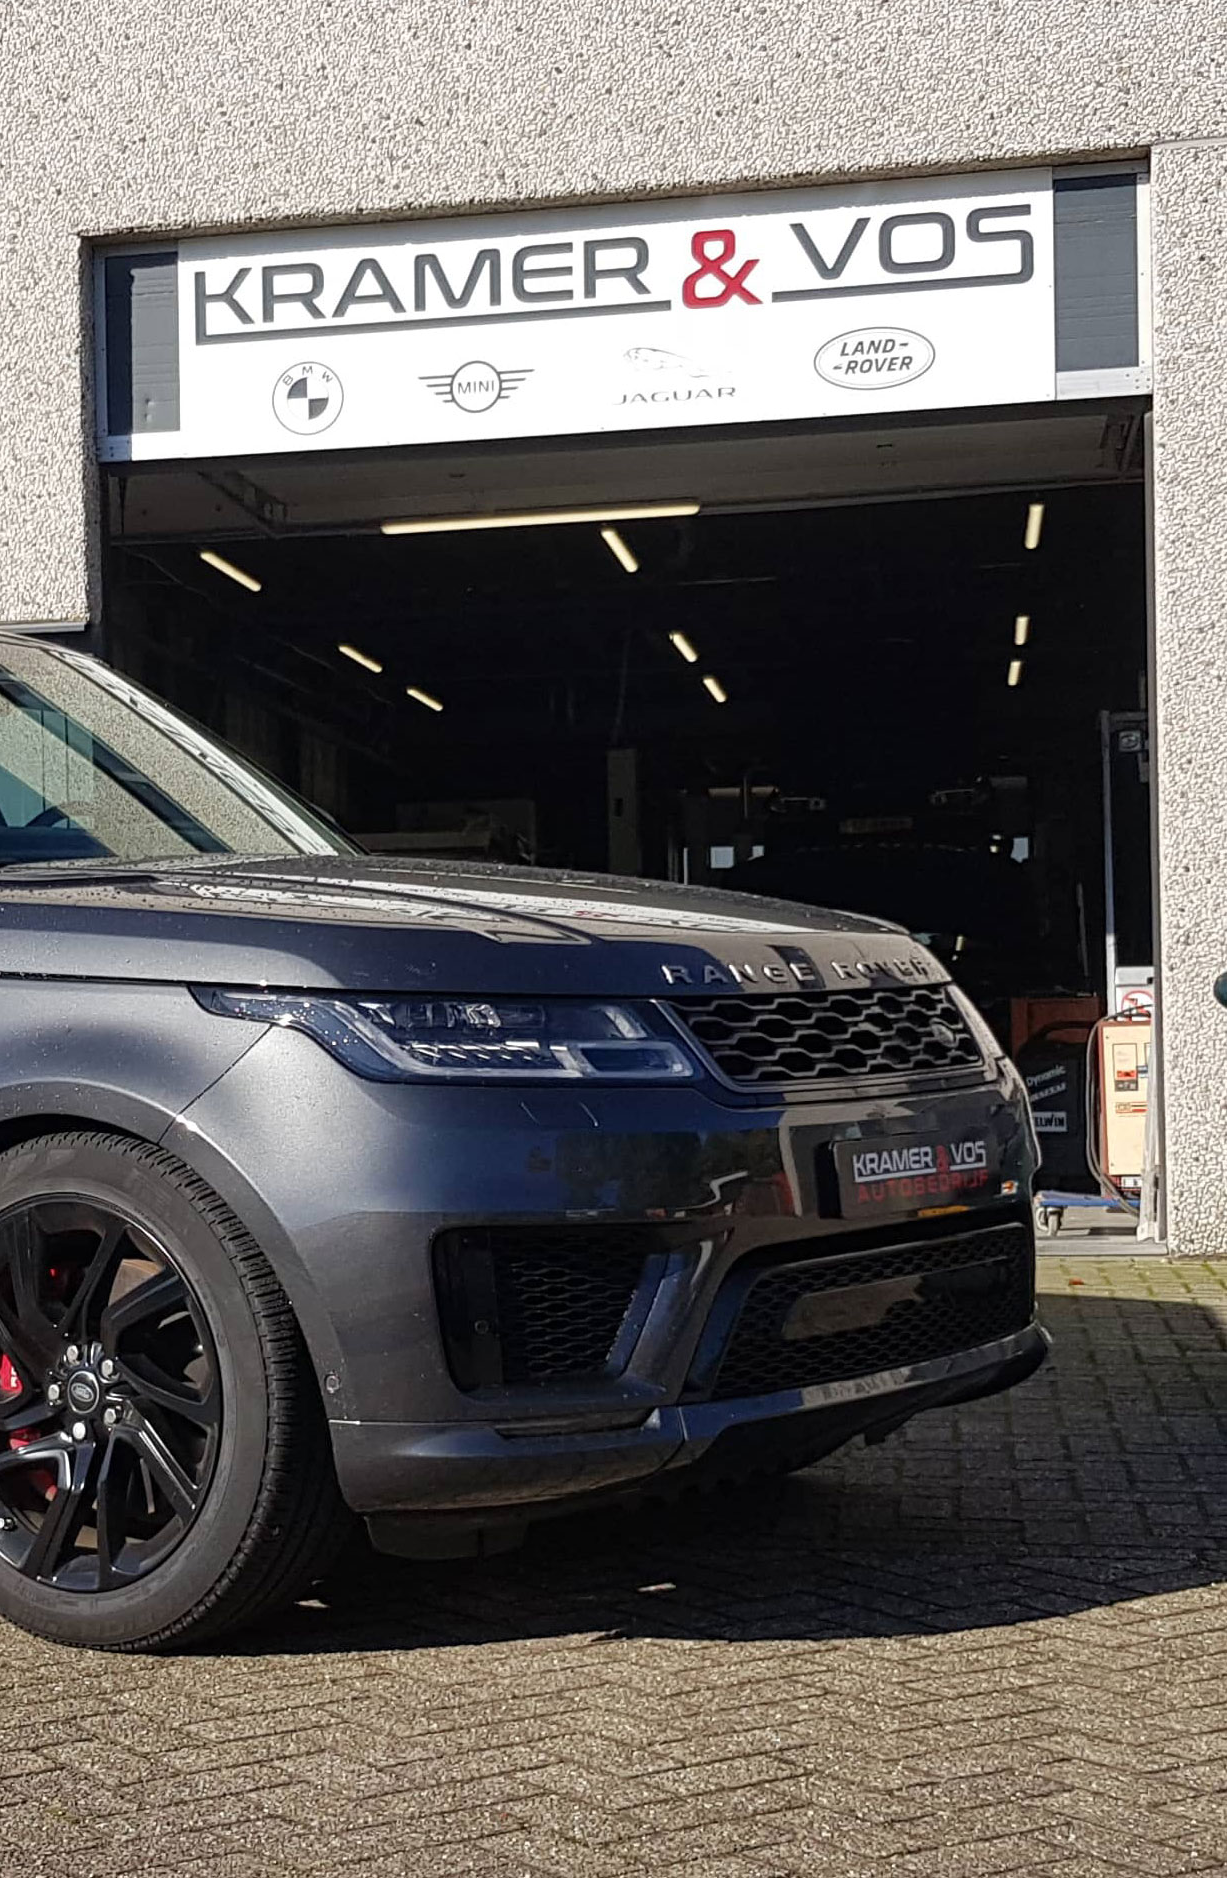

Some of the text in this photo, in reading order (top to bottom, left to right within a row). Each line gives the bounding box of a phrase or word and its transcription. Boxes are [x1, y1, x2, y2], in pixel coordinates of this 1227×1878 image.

[194, 203, 1035, 346] KRAMER & VOS
[282, 365, 334, 387] BMW
[457, 380, 495, 395] MINI
[613, 386, 737, 406] JAGUAR
[661, 956, 930, 985] RANGE ROVER
[852, 1146, 933, 1182] KRAMER
[950, 1140, 987, 1167] VOS
[857, 1168, 990, 1204] AUTOBEDRIJF
